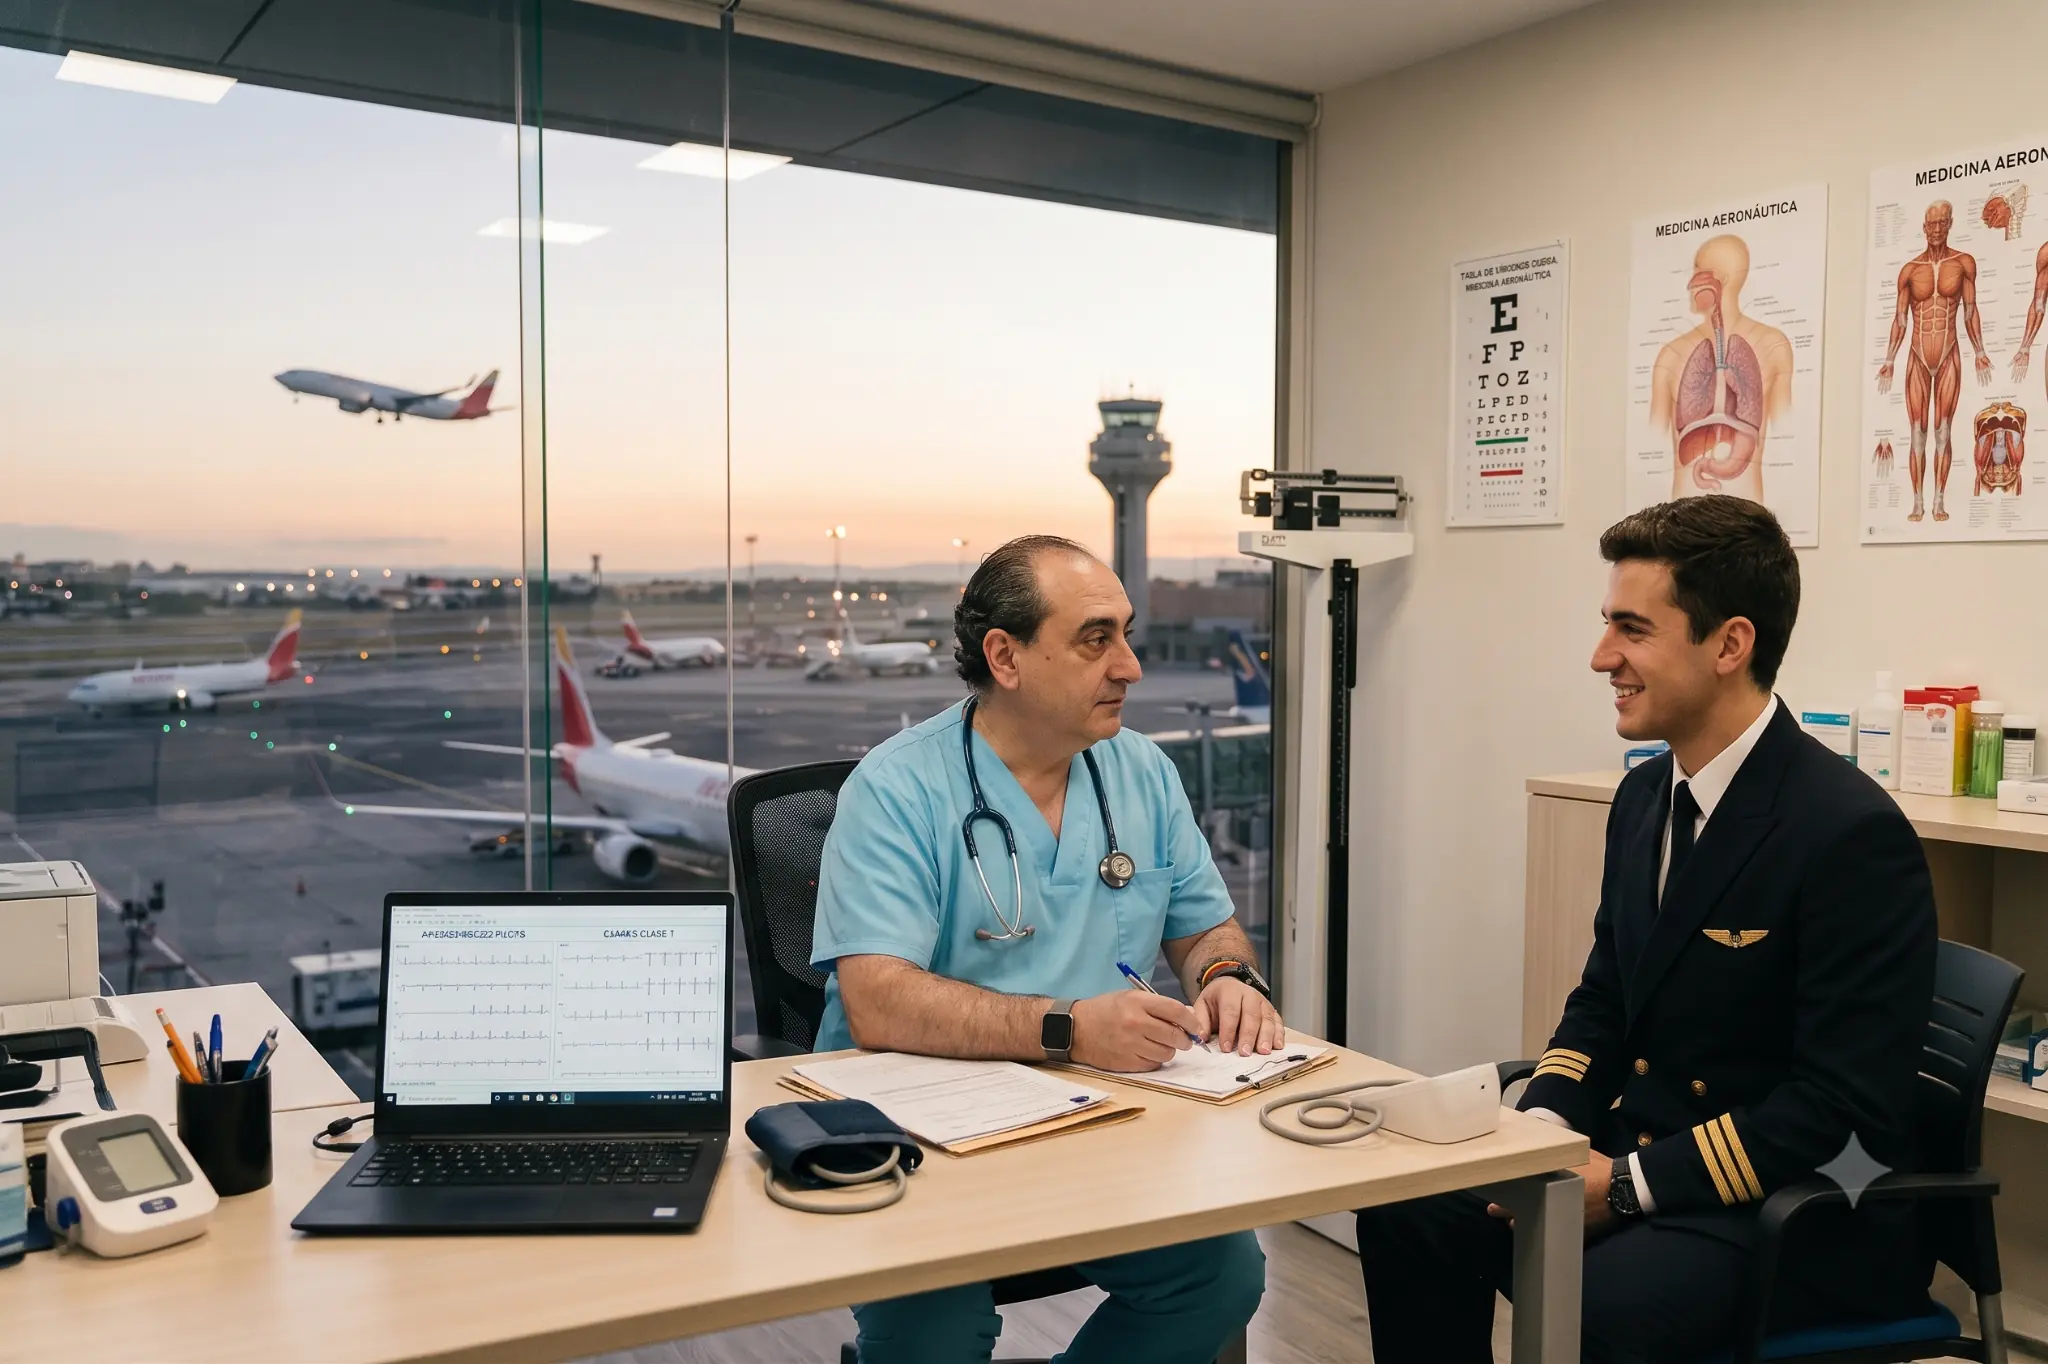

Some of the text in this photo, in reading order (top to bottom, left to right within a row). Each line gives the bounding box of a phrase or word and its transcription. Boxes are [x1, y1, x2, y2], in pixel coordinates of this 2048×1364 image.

[1915, 159, 1991, 187] MEDICINA
[1655, 200, 1798, 237] MEDICINA AERONÁUTICA
[1483, 267, 1494, 277] DE
[1490, 293, 1518, 334] E
[639, 930, 667, 938] CLASE
